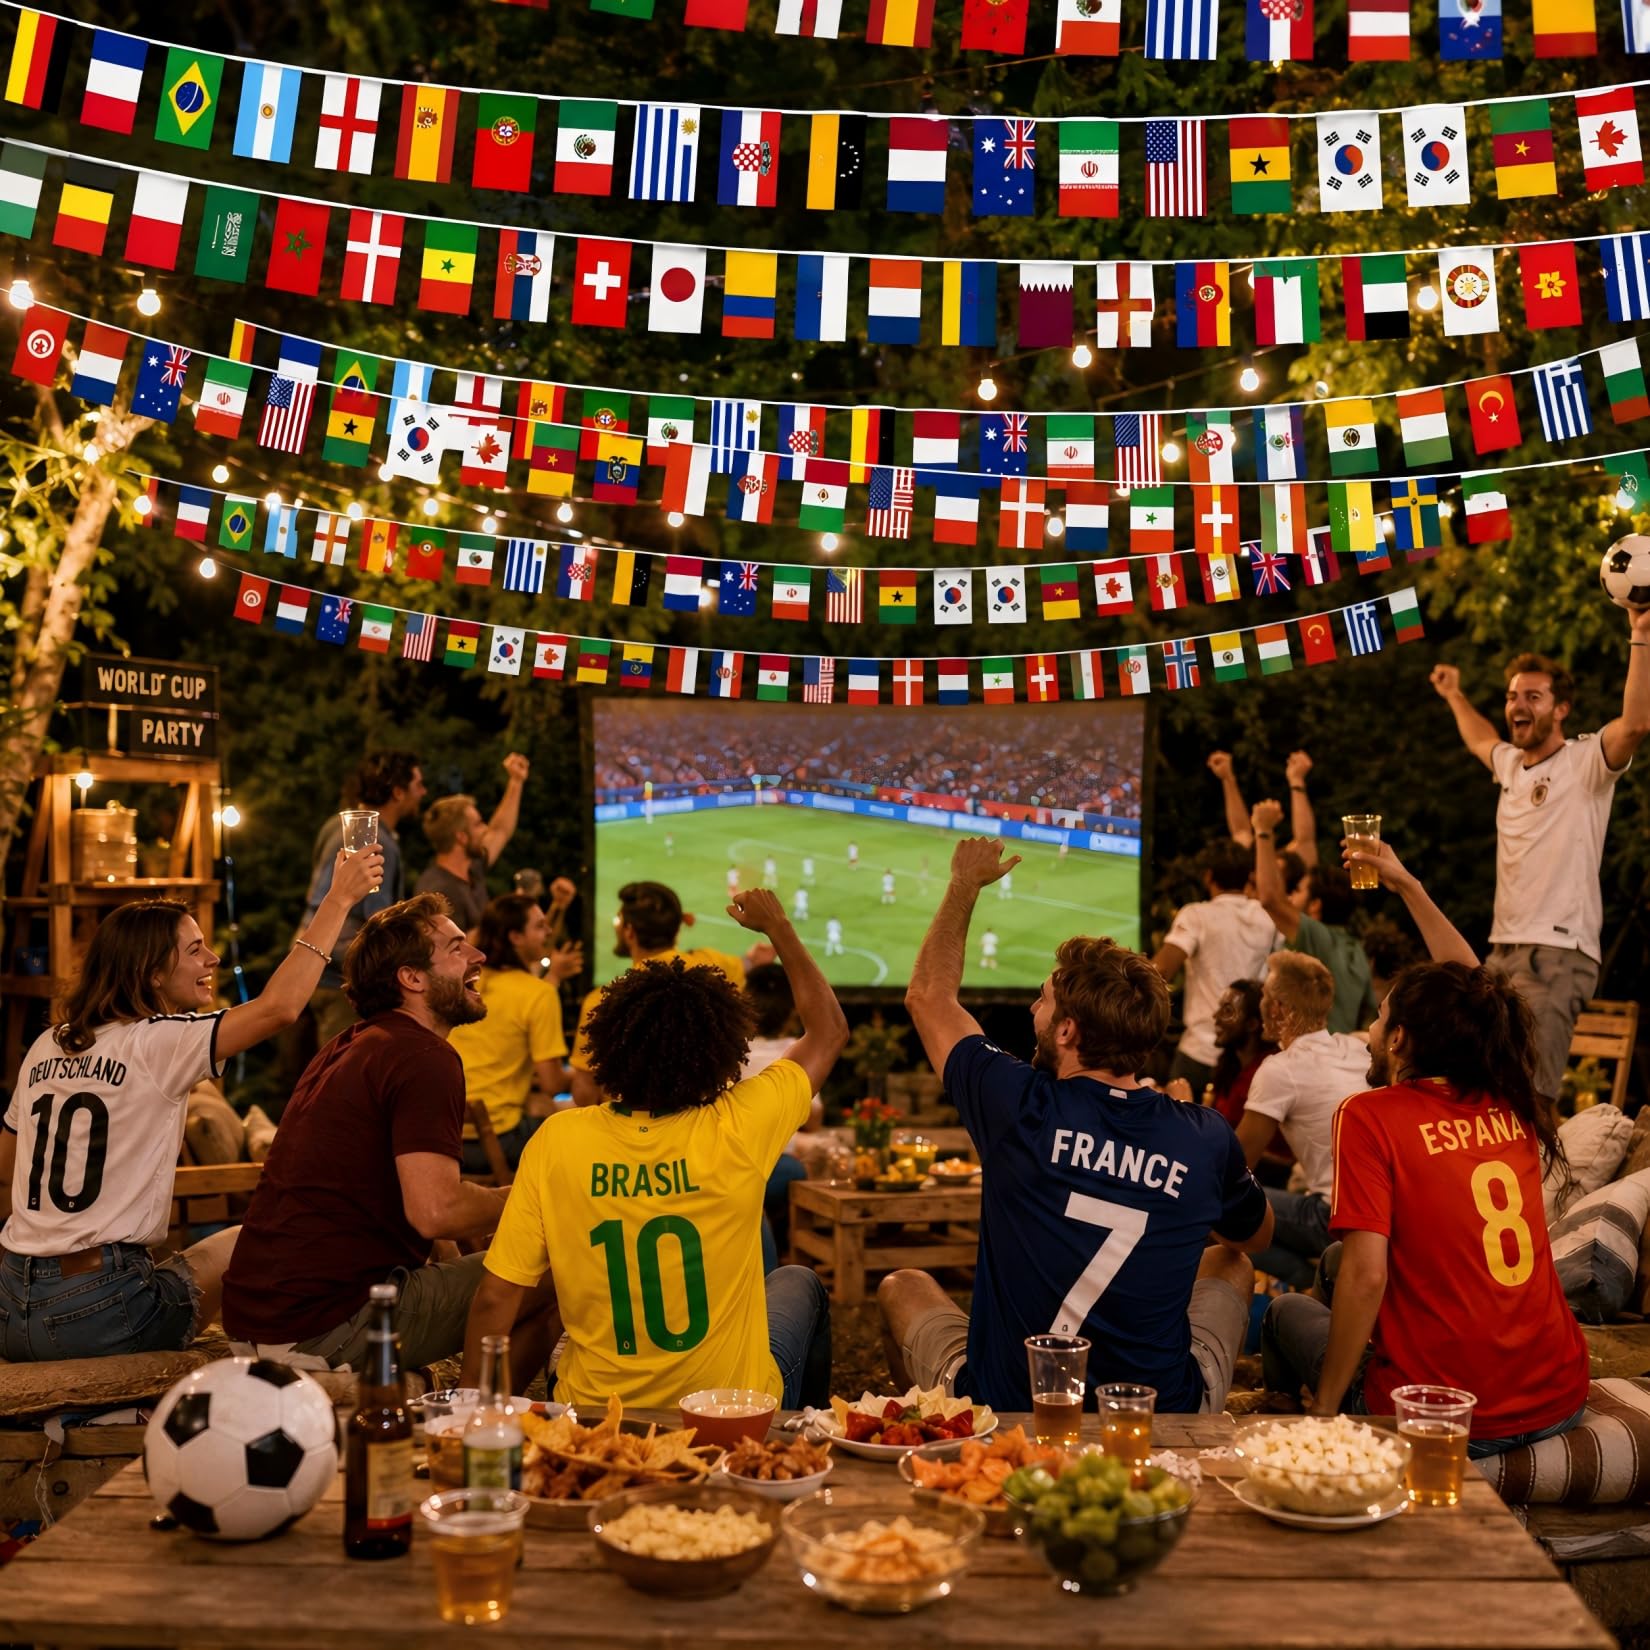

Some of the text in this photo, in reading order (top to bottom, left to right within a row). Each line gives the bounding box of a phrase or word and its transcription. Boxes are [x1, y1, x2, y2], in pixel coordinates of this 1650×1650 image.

[98, 667, 207, 700] WORLD CUP
[142, 719, 204, 747] PARTY
[28, 1055, 127, 1088] DEUTSCHLAND
[27, 1091, 109, 1213] 10
[1418, 1107, 1527, 1155] ESPAÑA
[591, 1158, 700, 1197] BRASIL
[1050, 1128, 1188, 1198] FRANCE
[1470, 1160, 1534, 1287] 8
[589, 1214, 710, 1355] 10
[1049, 1191, 1149, 1337] 7
